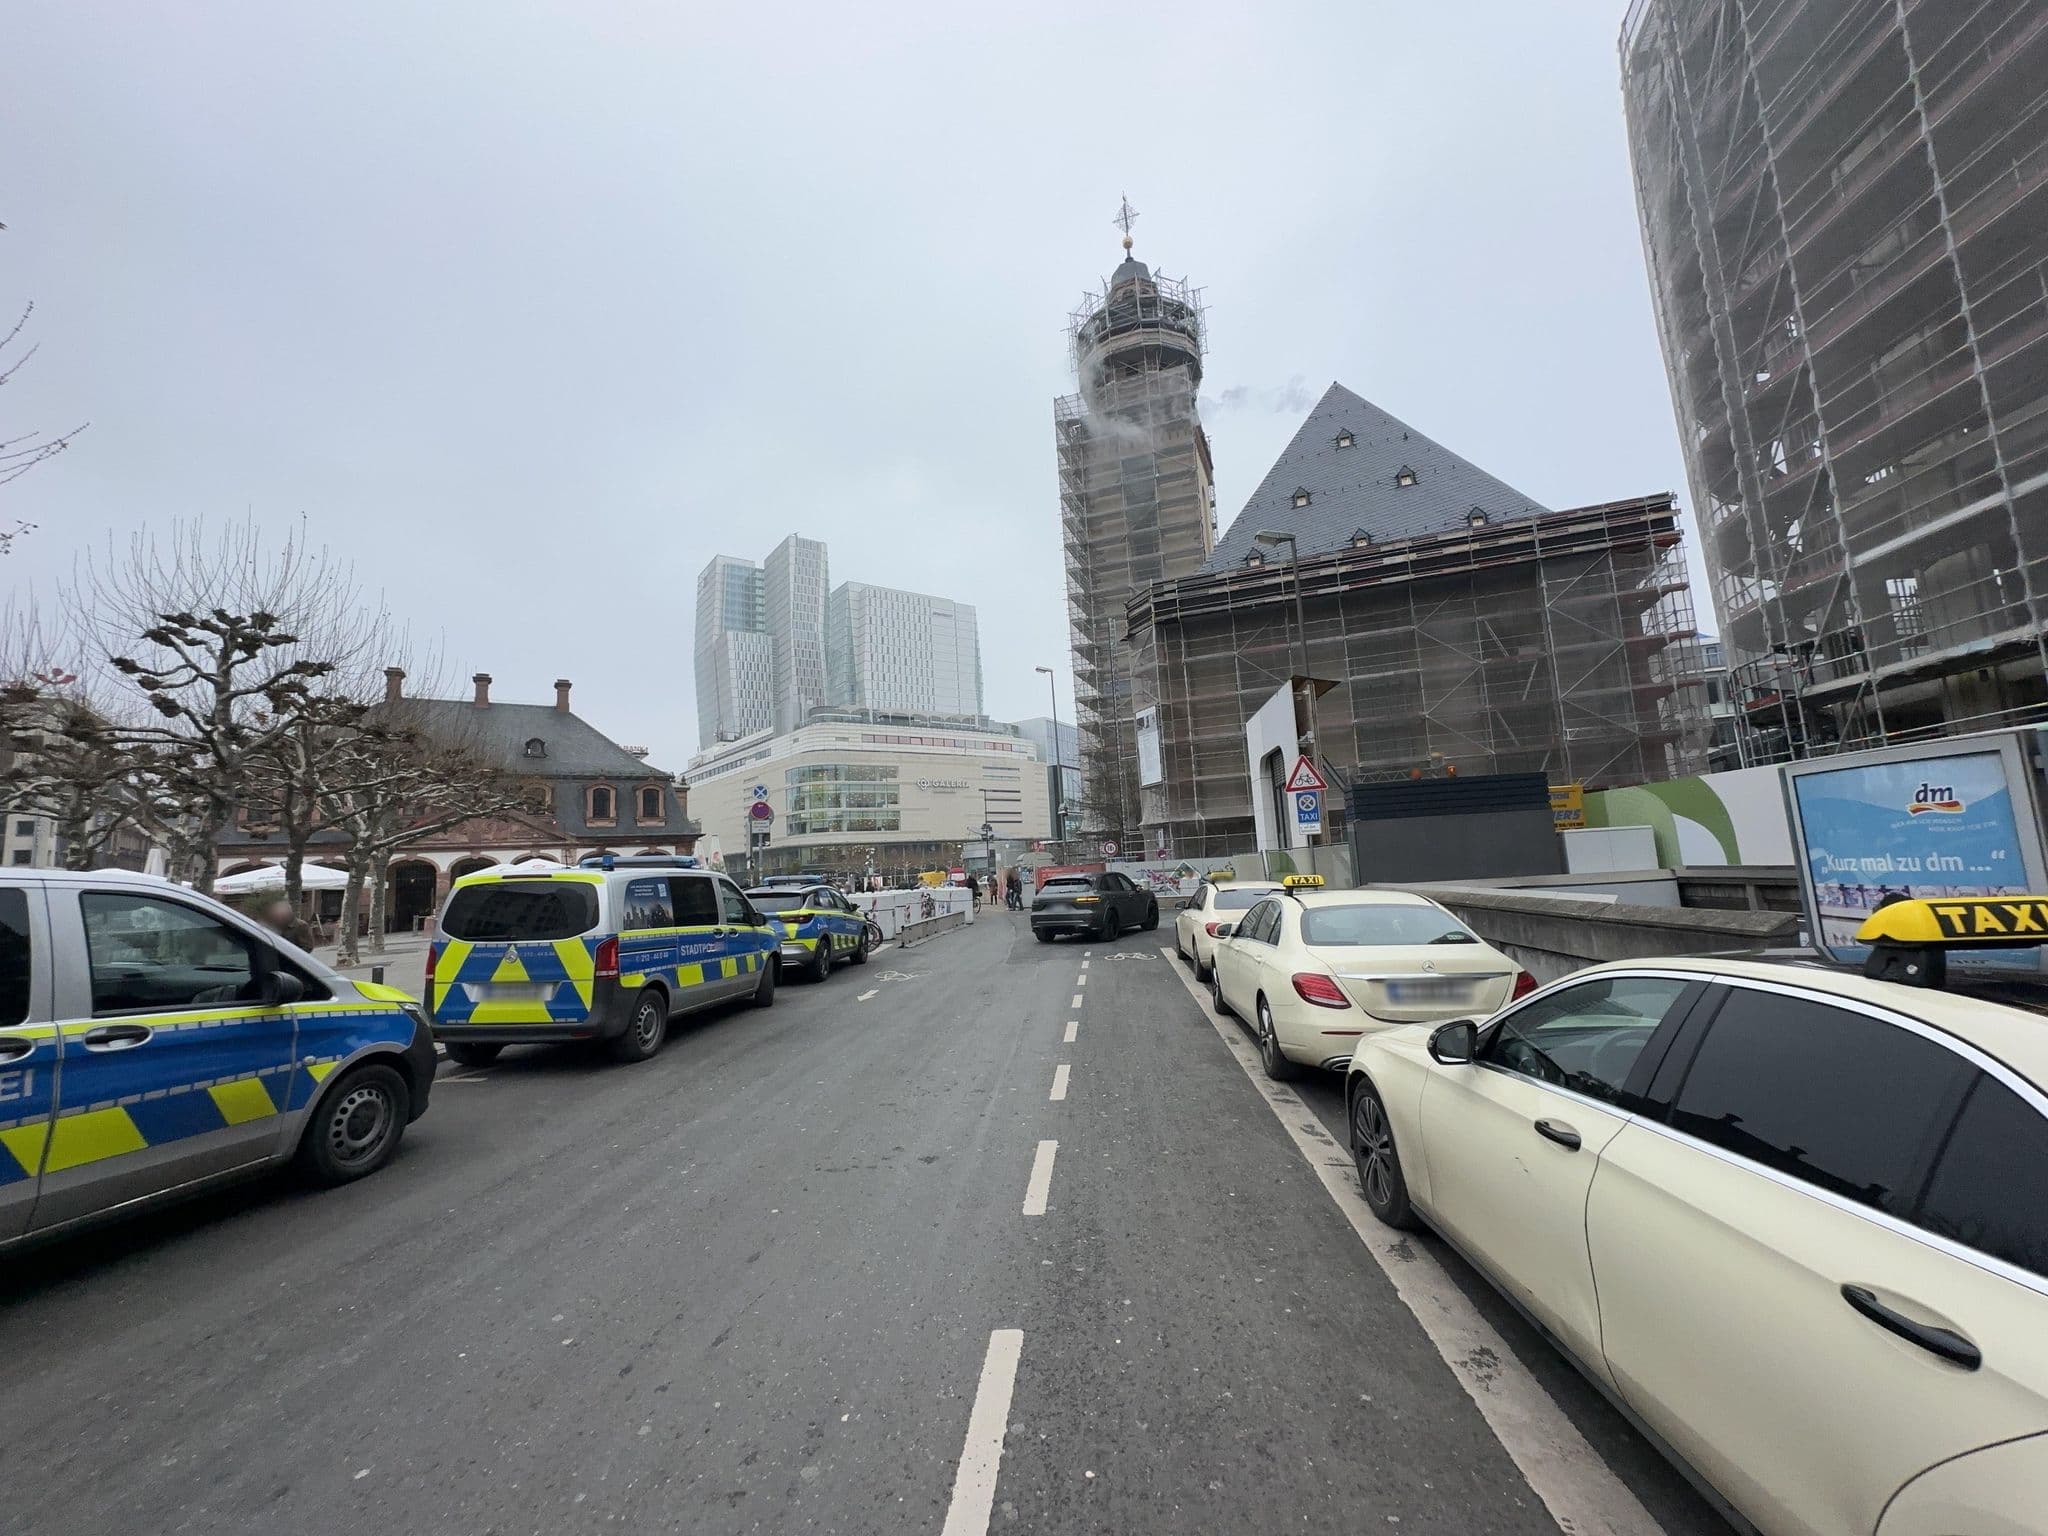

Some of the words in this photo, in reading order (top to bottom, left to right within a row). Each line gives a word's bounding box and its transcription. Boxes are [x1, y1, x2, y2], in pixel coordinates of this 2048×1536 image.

[1915, 783, 1953, 803] dm
[1300, 812, 1319, 821] TAXI
[1861, 852, 1894, 872] mal
[1898, 856, 1920, 872] zu
[1925, 852, 1964, 872] dm
[1292, 876, 1319, 884] TAXI
